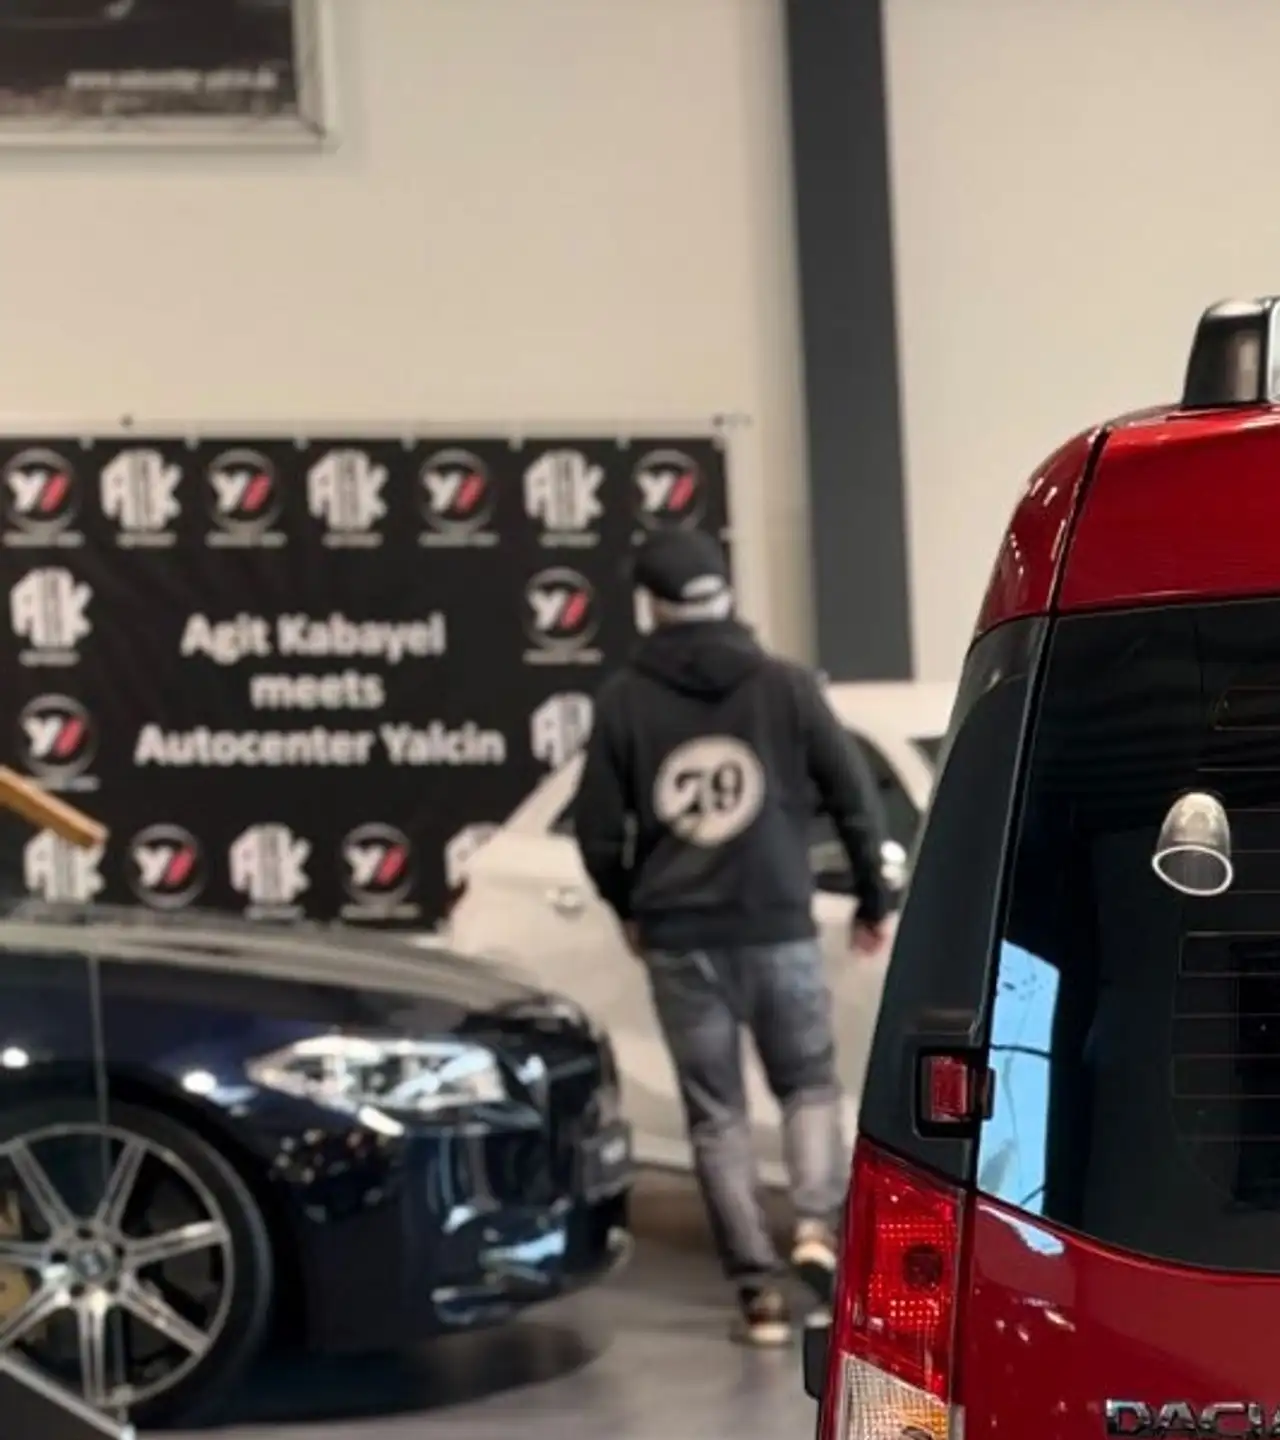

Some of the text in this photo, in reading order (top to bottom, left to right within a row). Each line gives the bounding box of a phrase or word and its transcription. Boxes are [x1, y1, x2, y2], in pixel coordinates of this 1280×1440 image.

[181, 611, 447, 665] Agit Kabayel
[250, 668, 386, 710] meets
[134, 720, 507, 766] Autocenter Yalcin
